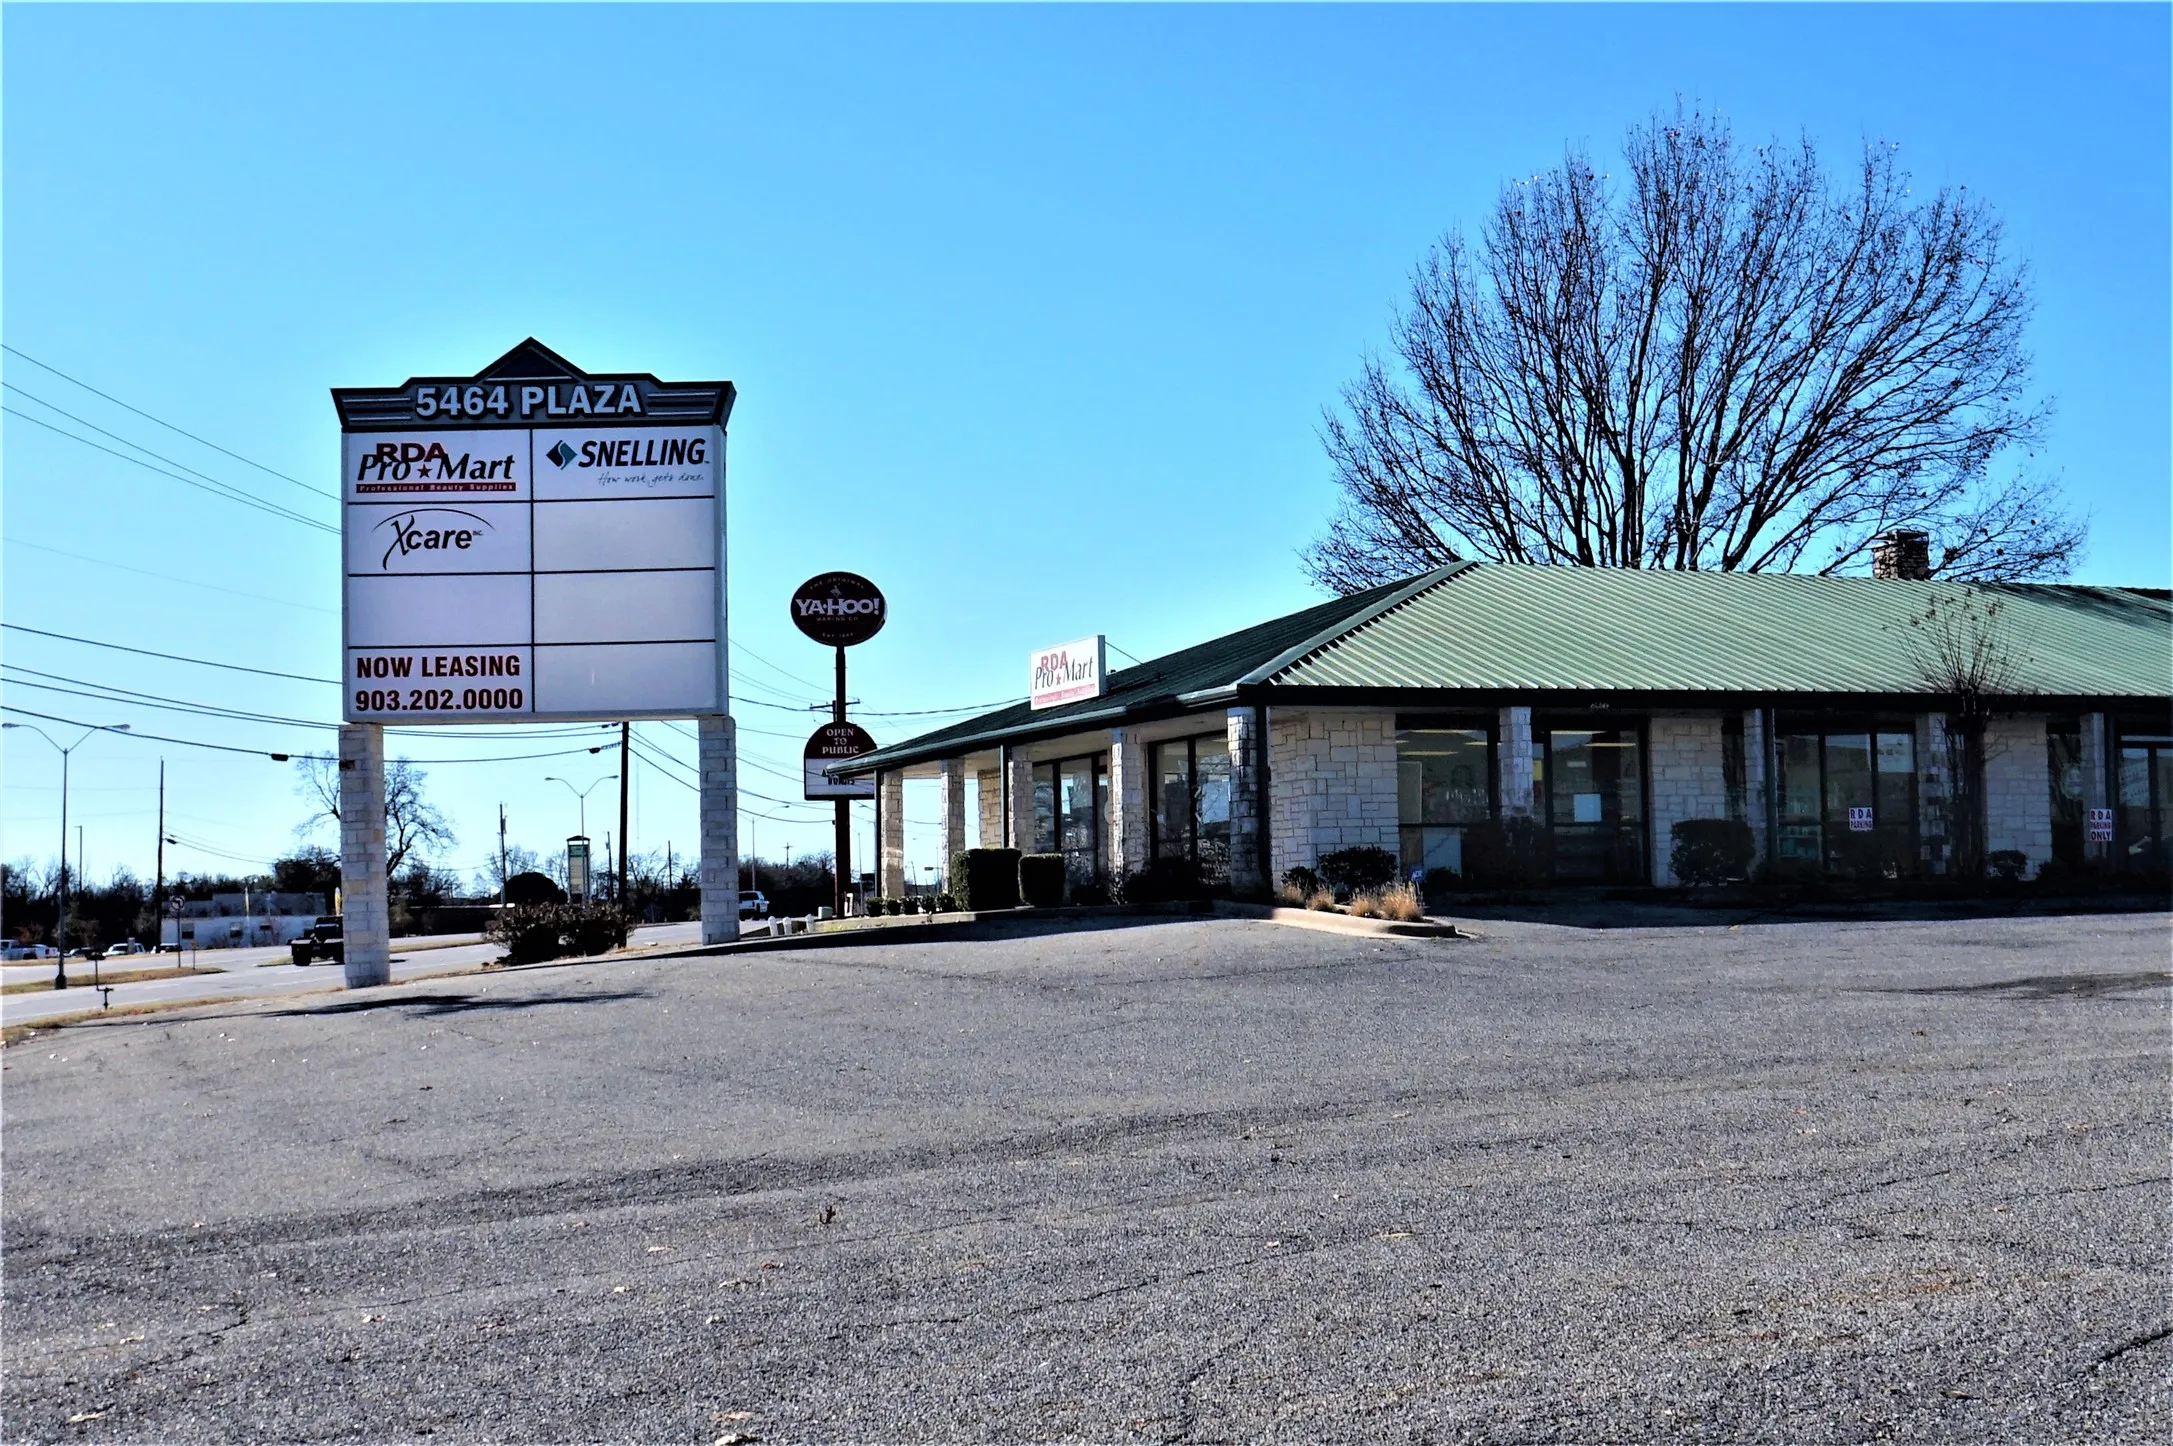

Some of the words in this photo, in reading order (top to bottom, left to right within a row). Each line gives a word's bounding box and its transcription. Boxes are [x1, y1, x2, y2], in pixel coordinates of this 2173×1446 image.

[415, 386, 509, 416] 5464
[521, 384, 642, 415] PLAZA
[376, 442, 446, 463] RDA
[578, 438, 706, 468] SNELLING
[357, 454, 412, 481] Pro
[436, 453, 515, 480] Mart
[359, 484, 425, 492] Professional
[429, 483, 464, 492] Beauty
[470, 482, 514, 491] Supplies
[382, 514, 473, 571] Xcare
[357, 656, 413, 679] NOW
[421, 655, 520, 678] LEASING
[1041, 650, 1067, 671] RDA
[1035, 666, 1054, 690] Pro
[1063, 656, 1094, 683] Mart
[356, 688, 523, 711] 903.202.0000
[826, 728, 854, 737] OPEN
[833, 737, 847, 745] TO
[822, 746, 860, 754] PUBLIC
[2090, 831, 2111, 841] ONLY
